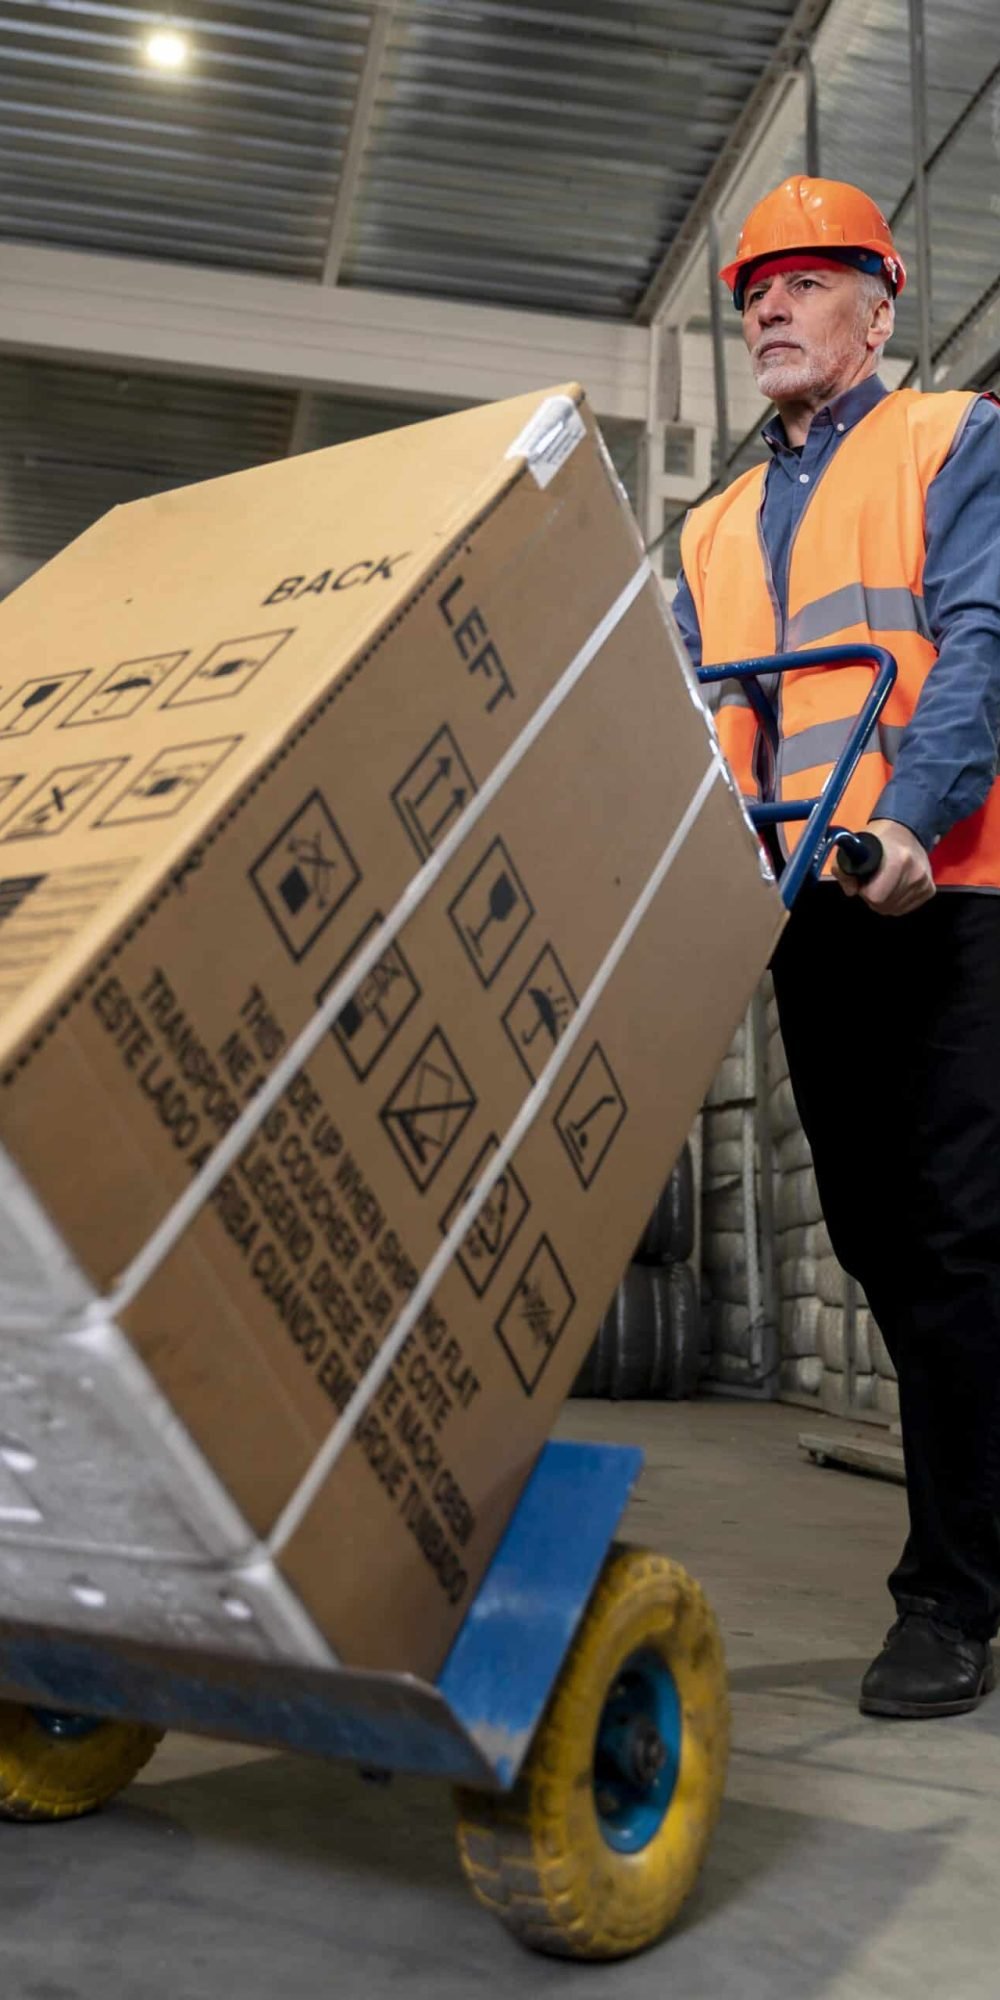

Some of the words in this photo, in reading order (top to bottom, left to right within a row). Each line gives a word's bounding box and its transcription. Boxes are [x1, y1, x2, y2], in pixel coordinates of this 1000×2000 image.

[260, 550, 413, 606] BACK
[438, 575, 516, 713] LEFT
[138, 968, 249, 1152] TRANSPOR
[219, 1029, 254, 1083] NE
[92, 974, 153, 1066] ESTE
[139, 1052, 202, 1151] LADO
[251, 1237, 327, 1366] CUANDO
[311, 1111, 343, 1166] UP
[335, 1153, 384, 1240] WHEN
[440, 1336, 478, 1411] FLAT
